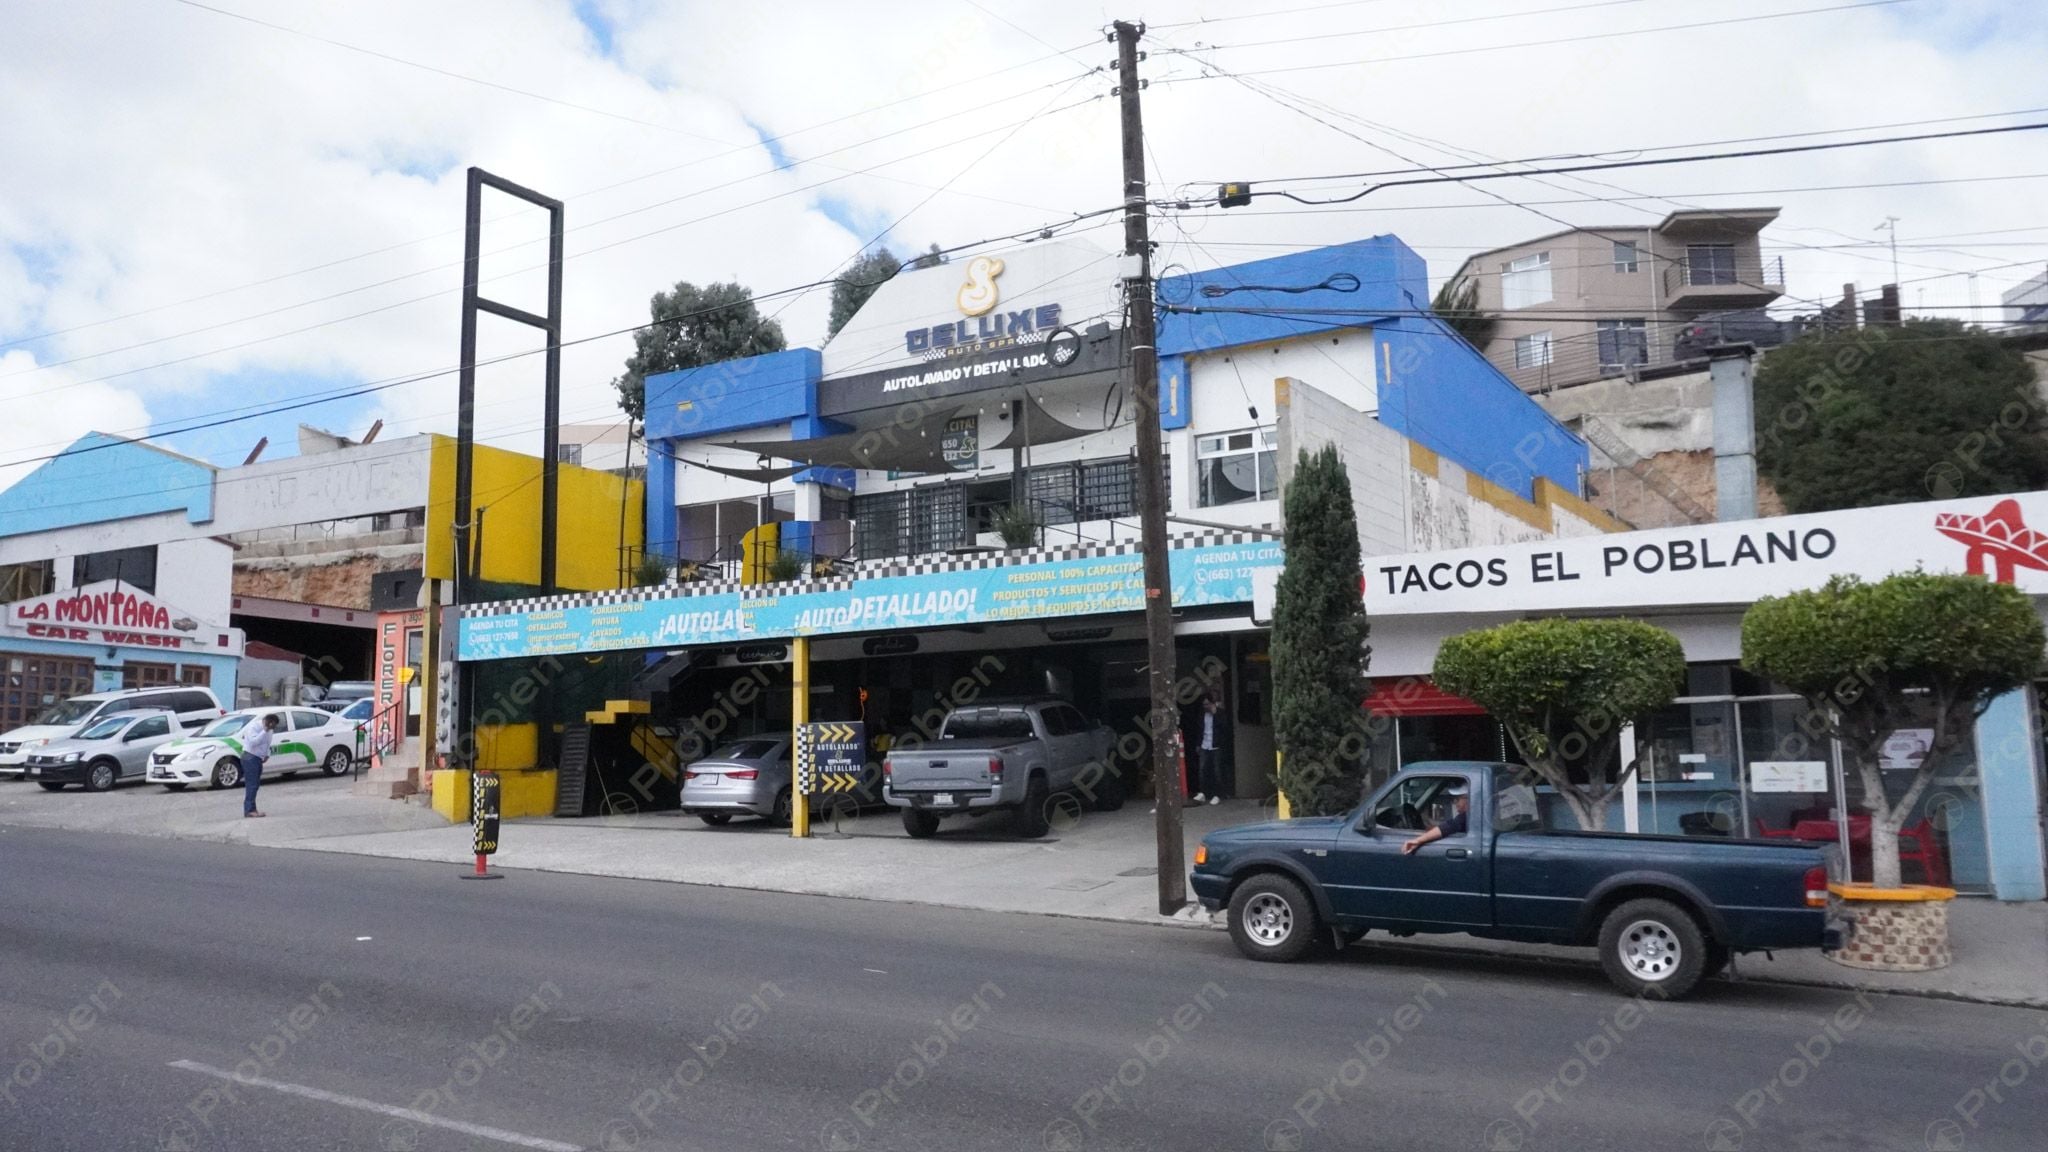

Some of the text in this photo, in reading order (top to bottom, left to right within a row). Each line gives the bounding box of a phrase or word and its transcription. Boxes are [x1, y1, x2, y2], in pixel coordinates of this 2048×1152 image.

[906, 303, 1061, 353] DELUXE
[947, 338, 1015, 356] AUTO SPA
[883, 368, 961, 392] AUTOLAVADO
[963, 365, 972, 378] Y
[1194, 548, 1282, 564] AGENDA TU CITA
[1380, 527, 1837, 594] TACOS EL POBLANO
[1008, 572, 1057, 584] PERSONAL
[1060, 569, 1085, 580] 100%
[993, 587, 1049, 601] PRODUCTOS
[1051, 586, 1057, 596] Y
[1059, 581, 1109, 596] SERVICIOS
[1111, 580, 1124, 591] DE
[18, 602, 49, 620] LA
[985, 608, 998, 618] LO
[1000, 605, 1030, 618] MEJOR
[27, 625, 181, 648] CAR WASH
[817, 743, 858, 751] AUTOLAVADO
[825, 764, 861, 772] DETALLADO
